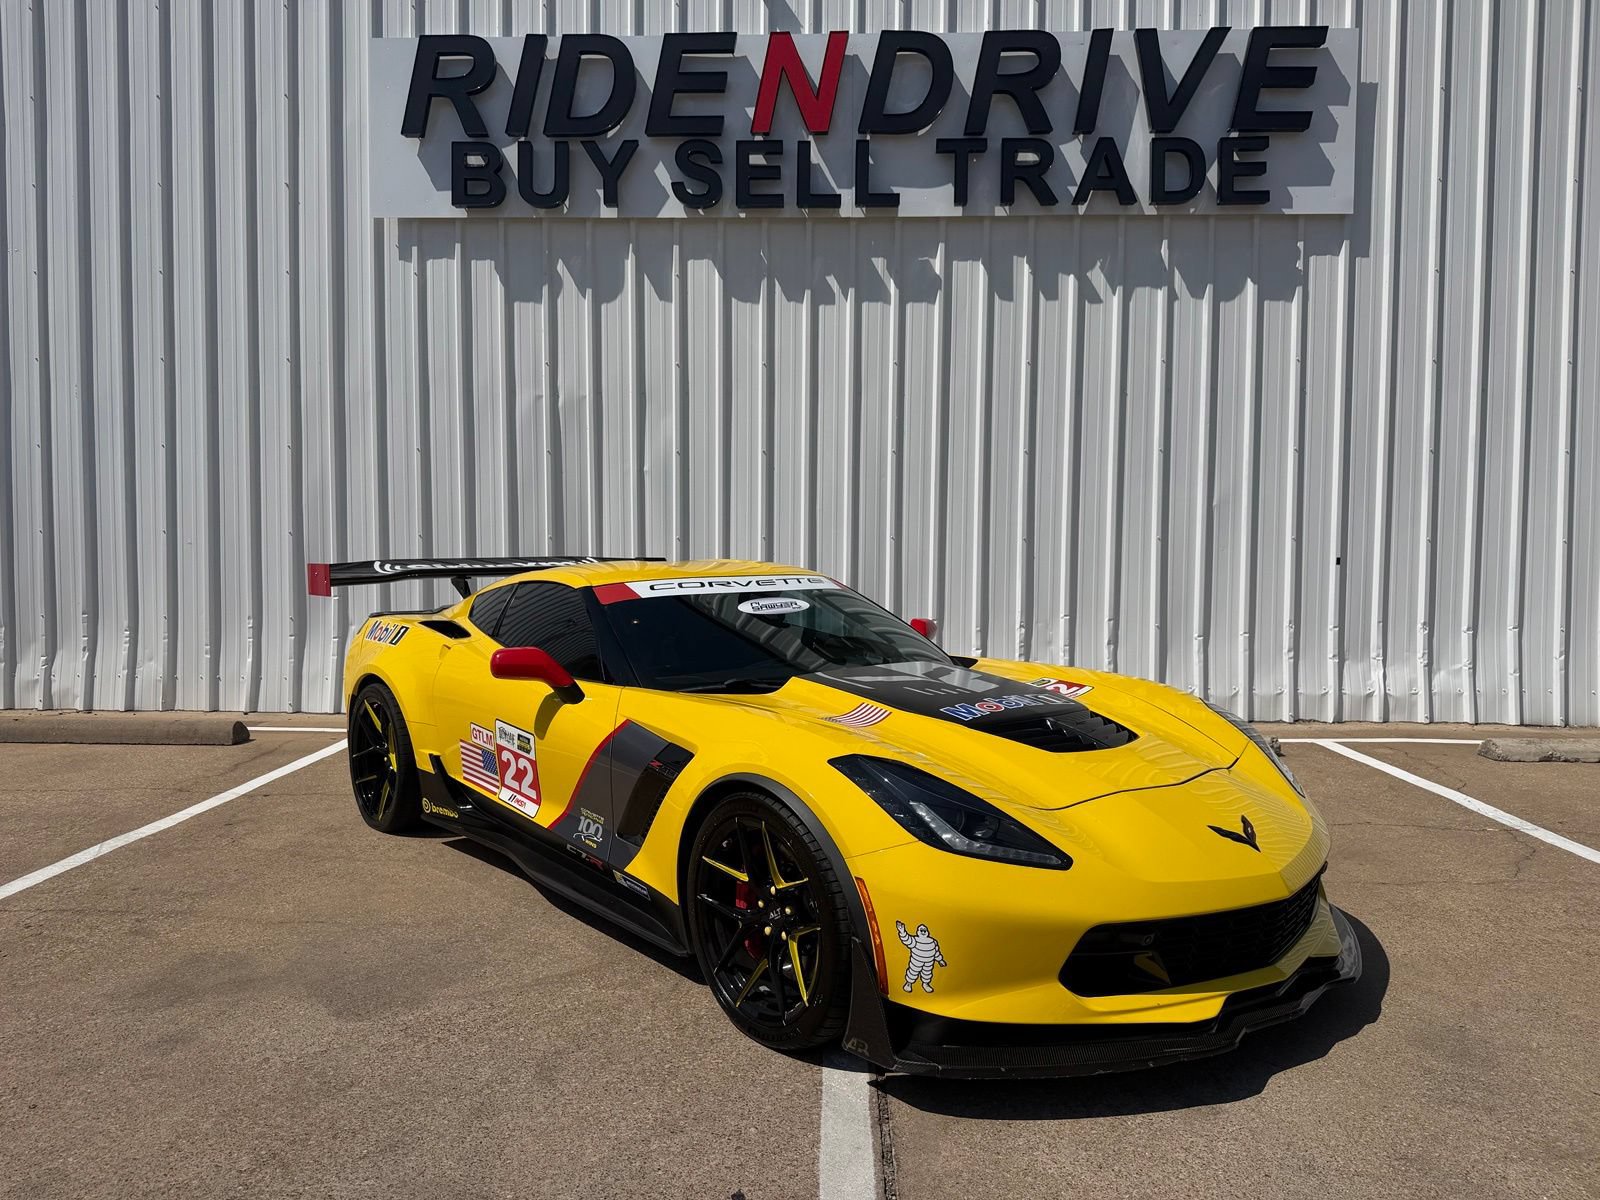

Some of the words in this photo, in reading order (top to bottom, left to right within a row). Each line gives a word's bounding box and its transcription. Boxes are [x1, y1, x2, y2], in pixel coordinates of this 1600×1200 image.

[451, 138, 639, 210] BUY
[671, 138, 900, 210] SELL
[936, 135, 1271, 207] TRADE
[649, 577, 824, 591] CORVETTE
[366, 620, 399, 643] Mobil
[939, 693, 1044, 722] Mobil
[471, 727, 494, 747] GTLM
[501, 750, 537, 800] 22
[430, 802, 459, 818] brembo
[578, 816, 603, 839] 100
